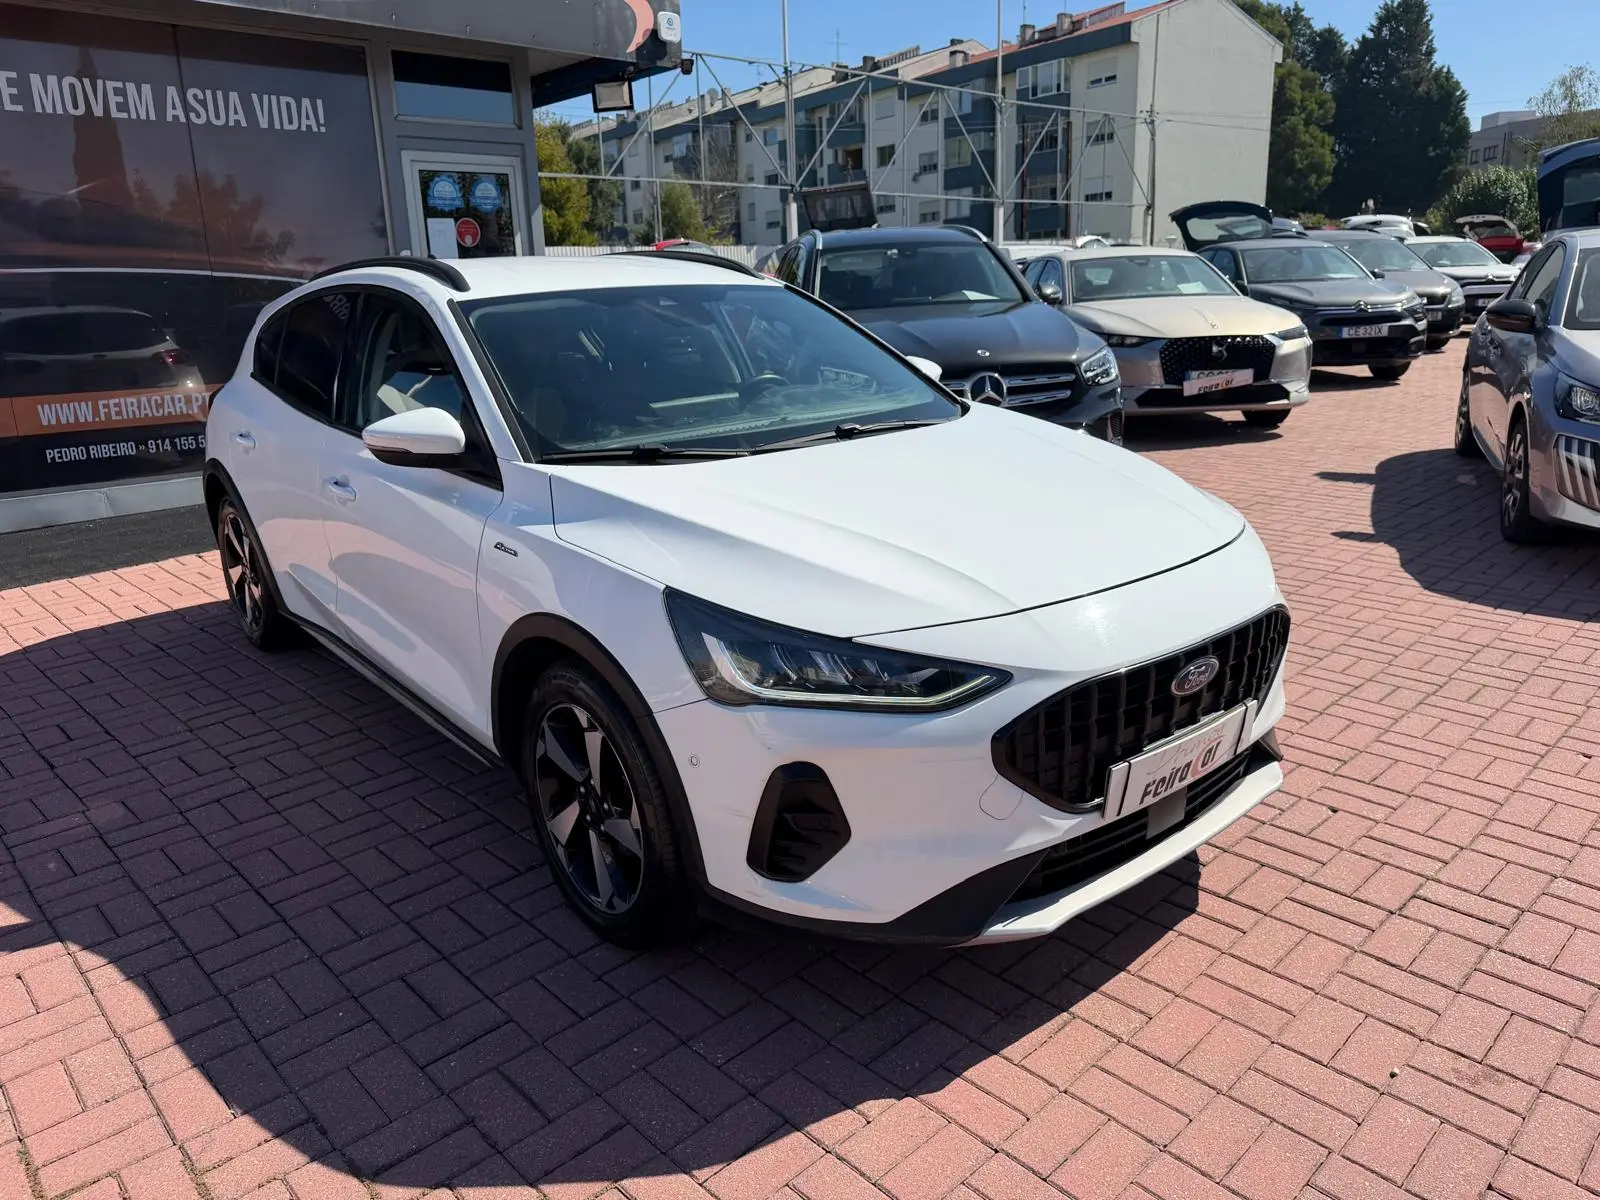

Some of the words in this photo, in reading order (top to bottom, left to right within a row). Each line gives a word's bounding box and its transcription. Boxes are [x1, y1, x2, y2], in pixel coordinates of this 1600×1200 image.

[29, 72, 157, 121] MOVEM
[251, 93, 328, 133] VIDA!
[46, 446, 87, 463] PEDRO
[91, 441, 136, 459] RIBEIRO
[148, 438, 171, 453] 914
[174, 435, 196, 450] 155
